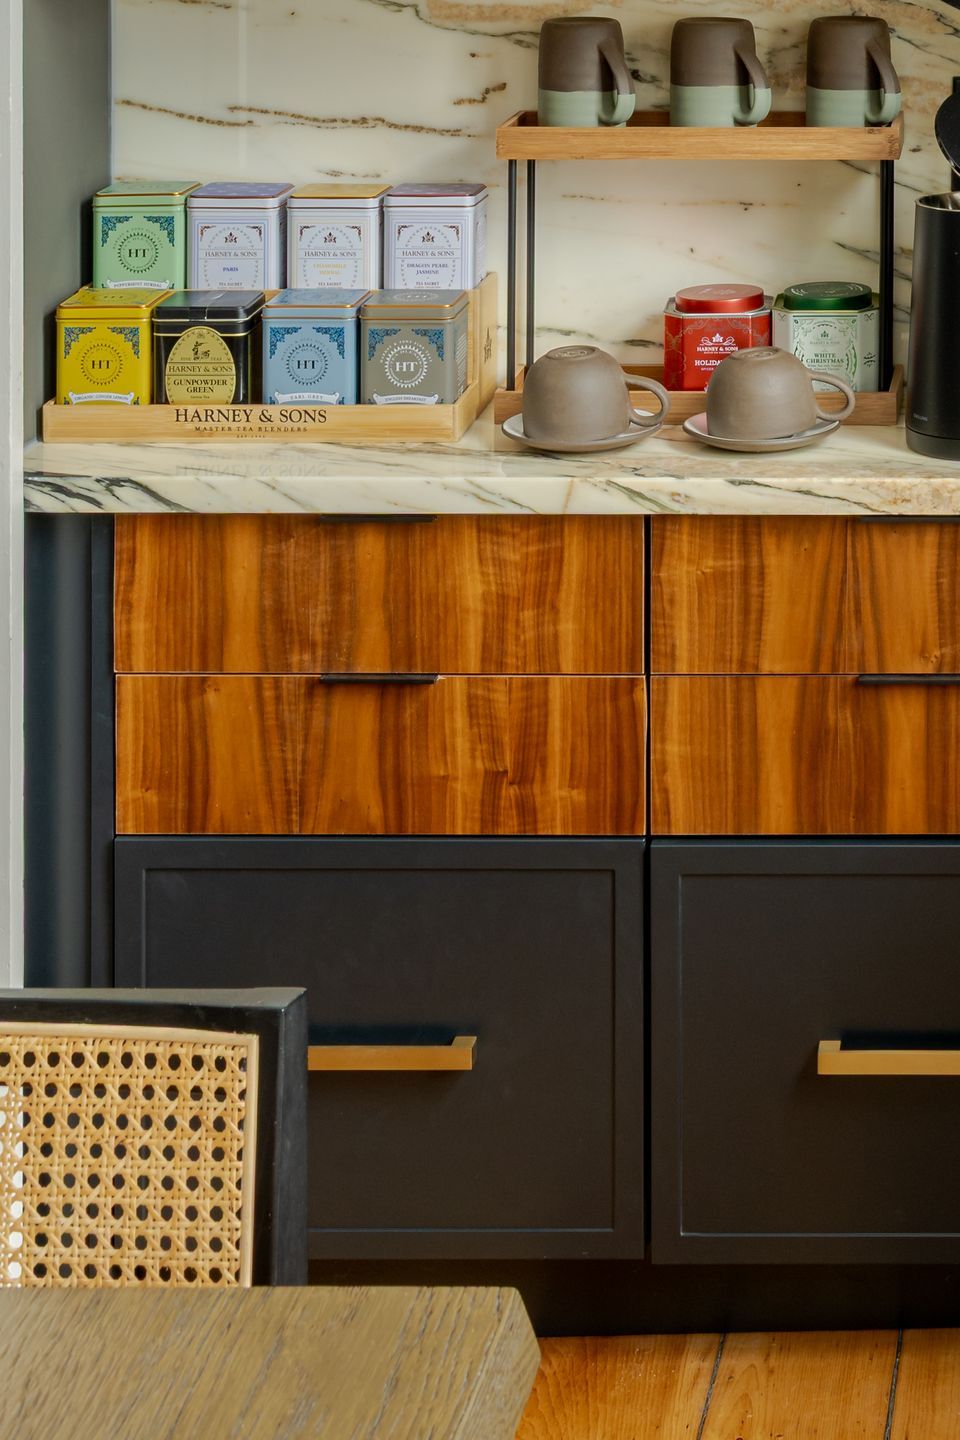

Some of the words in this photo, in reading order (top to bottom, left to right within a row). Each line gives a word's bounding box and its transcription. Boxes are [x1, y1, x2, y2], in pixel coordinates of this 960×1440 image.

[128, 248, 149, 258] HT
[92, 360, 113, 369] HT
[168, 365, 202, 373] HARNEY
[203, 365, 210, 373] &
[212, 365, 233, 373] SONS
[297, 360, 319, 369] HT
[395, 361, 418, 372] HT
[175, 409, 253, 422] HARNEY
[258, 409, 274, 423] &
[279, 409, 327, 423] SONS
